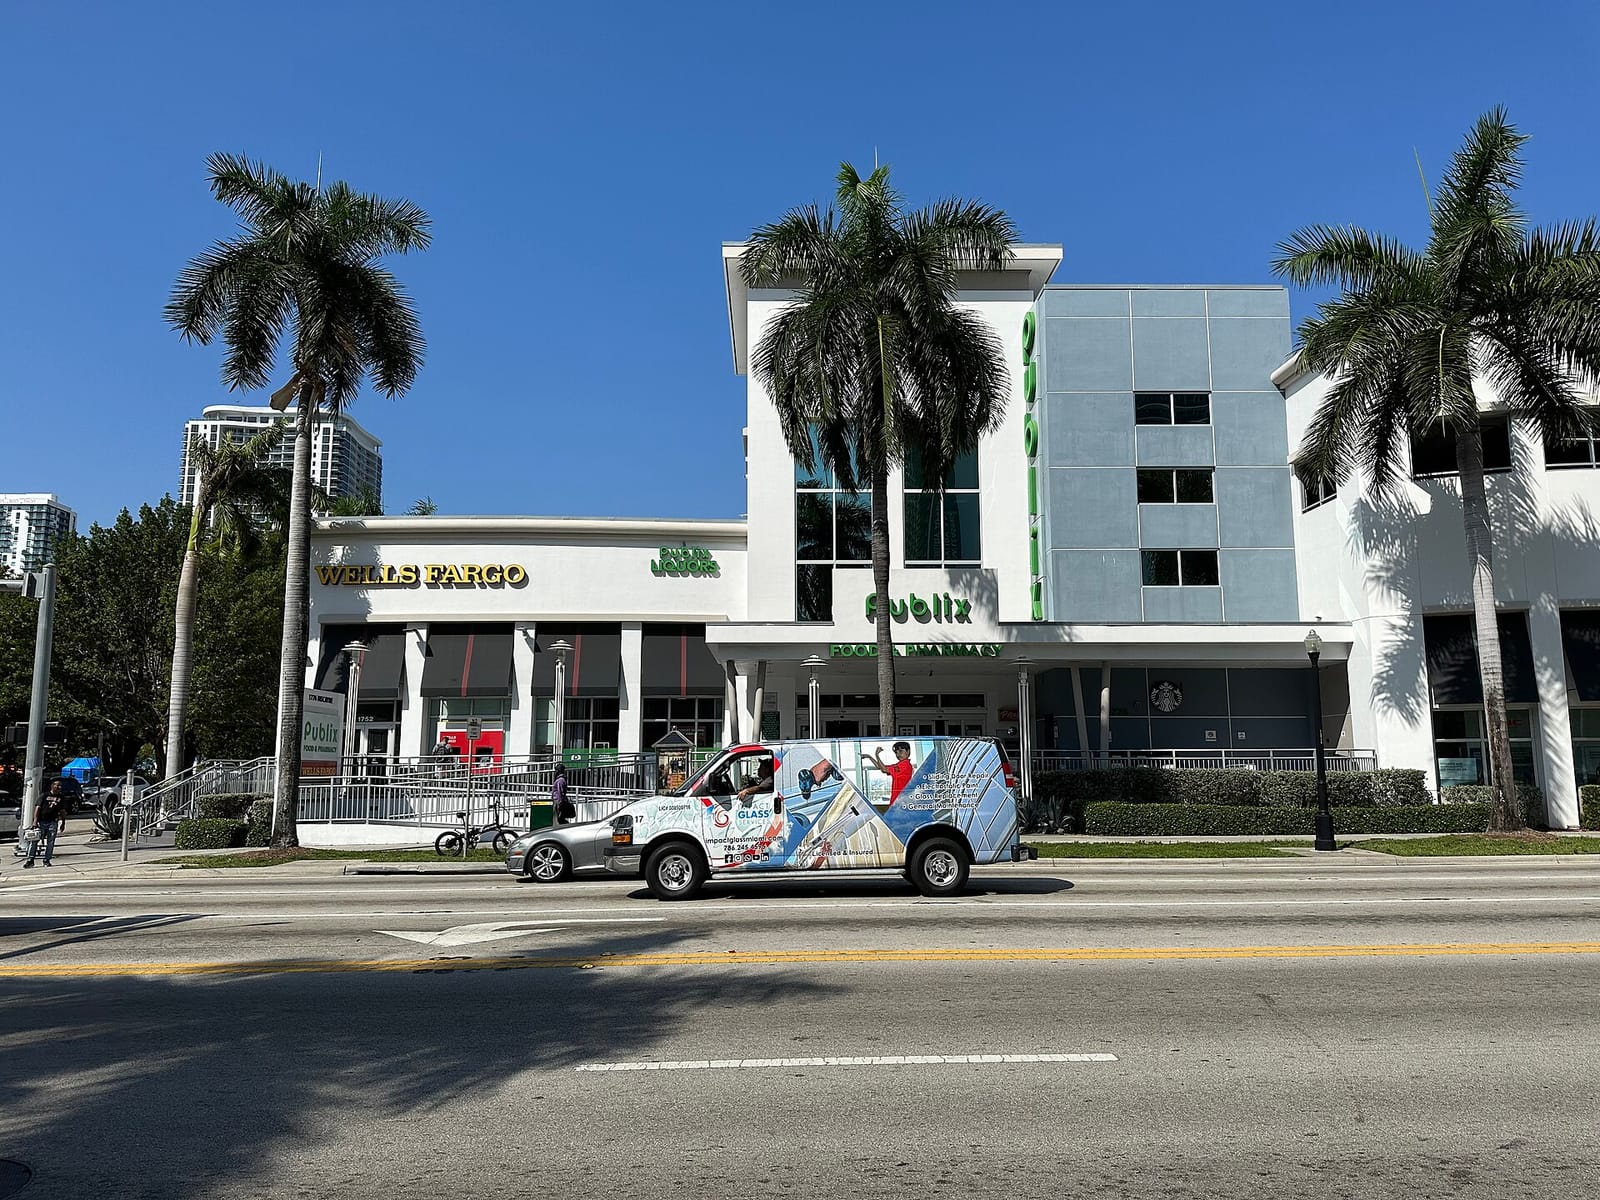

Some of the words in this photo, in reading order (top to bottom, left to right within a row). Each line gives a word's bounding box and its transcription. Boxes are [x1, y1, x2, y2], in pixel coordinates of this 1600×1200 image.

[660, 546, 709, 559] Publix
[651, 559, 718, 572] LIQUORS
[314, 564, 417, 585] WELLS
[424, 563, 526, 585] FARGO
[905, 644, 1003, 657] PHARMACY
[303, 721, 338, 743] Publix
[915, 792, 932, 800] Glass
[934, 792, 978, 800] Replacement
[908, 802, 935, 810] General
[936, 802, 978, 810] Maintenance
[634, 815, 643, 823] 17
[738, 810, 769, 818] GLASS
